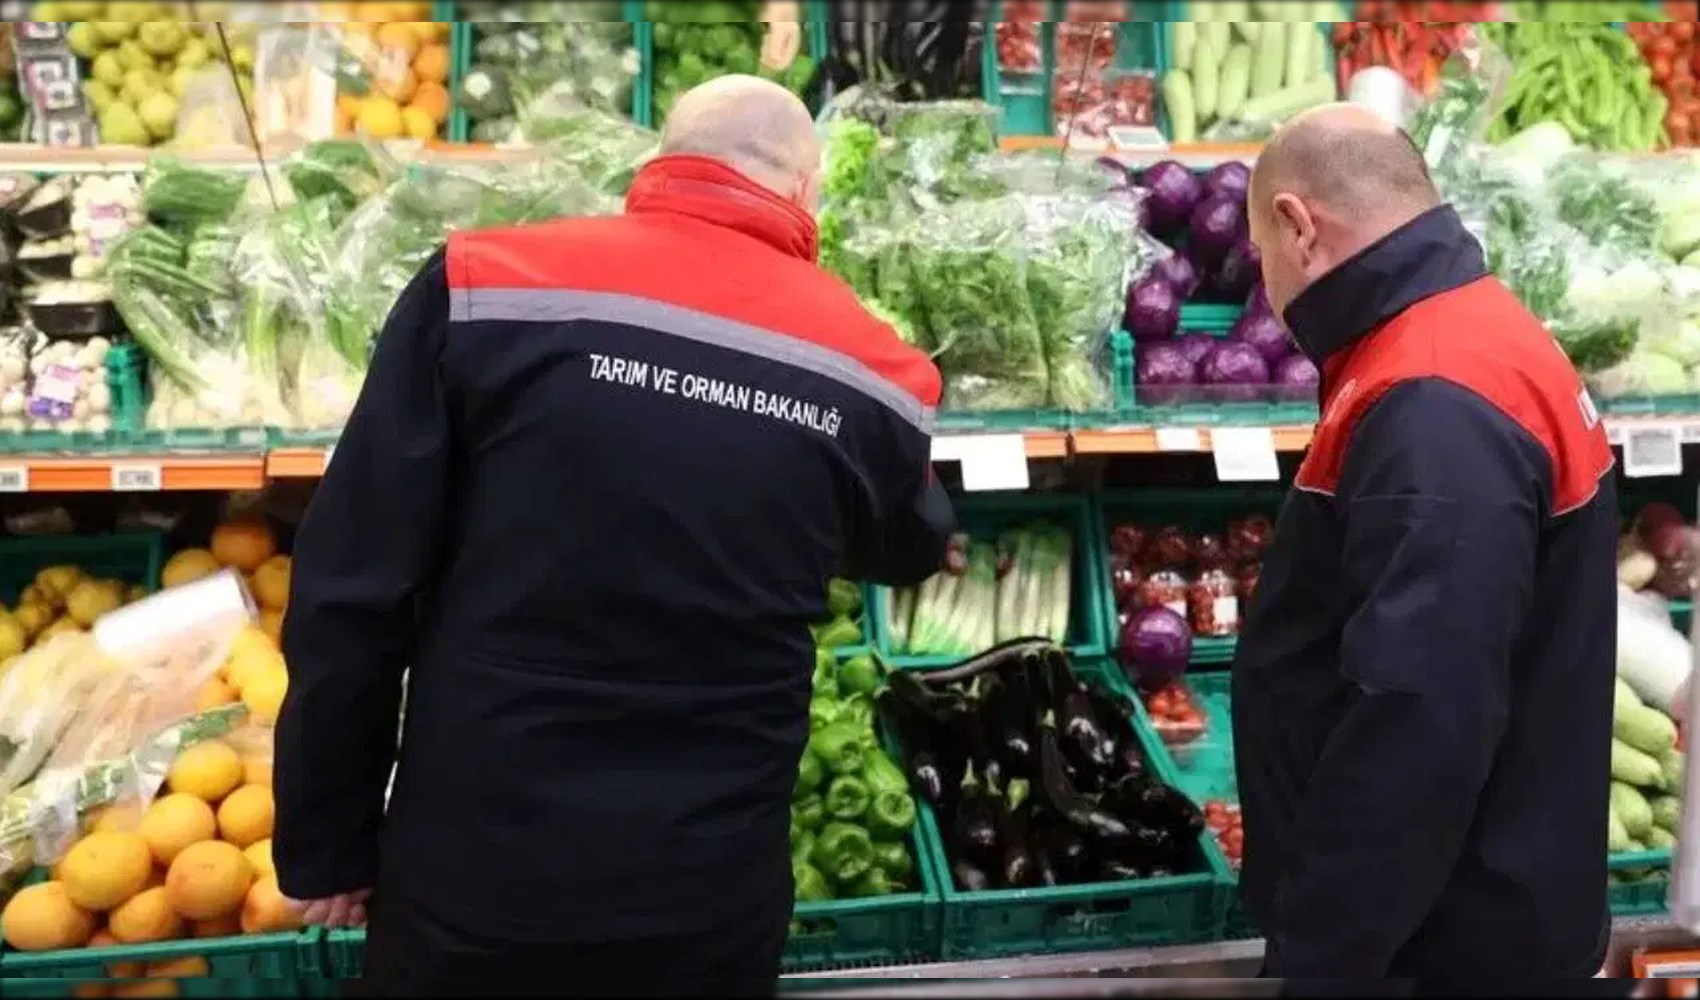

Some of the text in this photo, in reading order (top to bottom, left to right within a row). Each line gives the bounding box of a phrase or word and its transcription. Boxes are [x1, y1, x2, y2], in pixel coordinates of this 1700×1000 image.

[590, 354, 841, 436] TARIM VE ORMAN BAKANLIĞI
